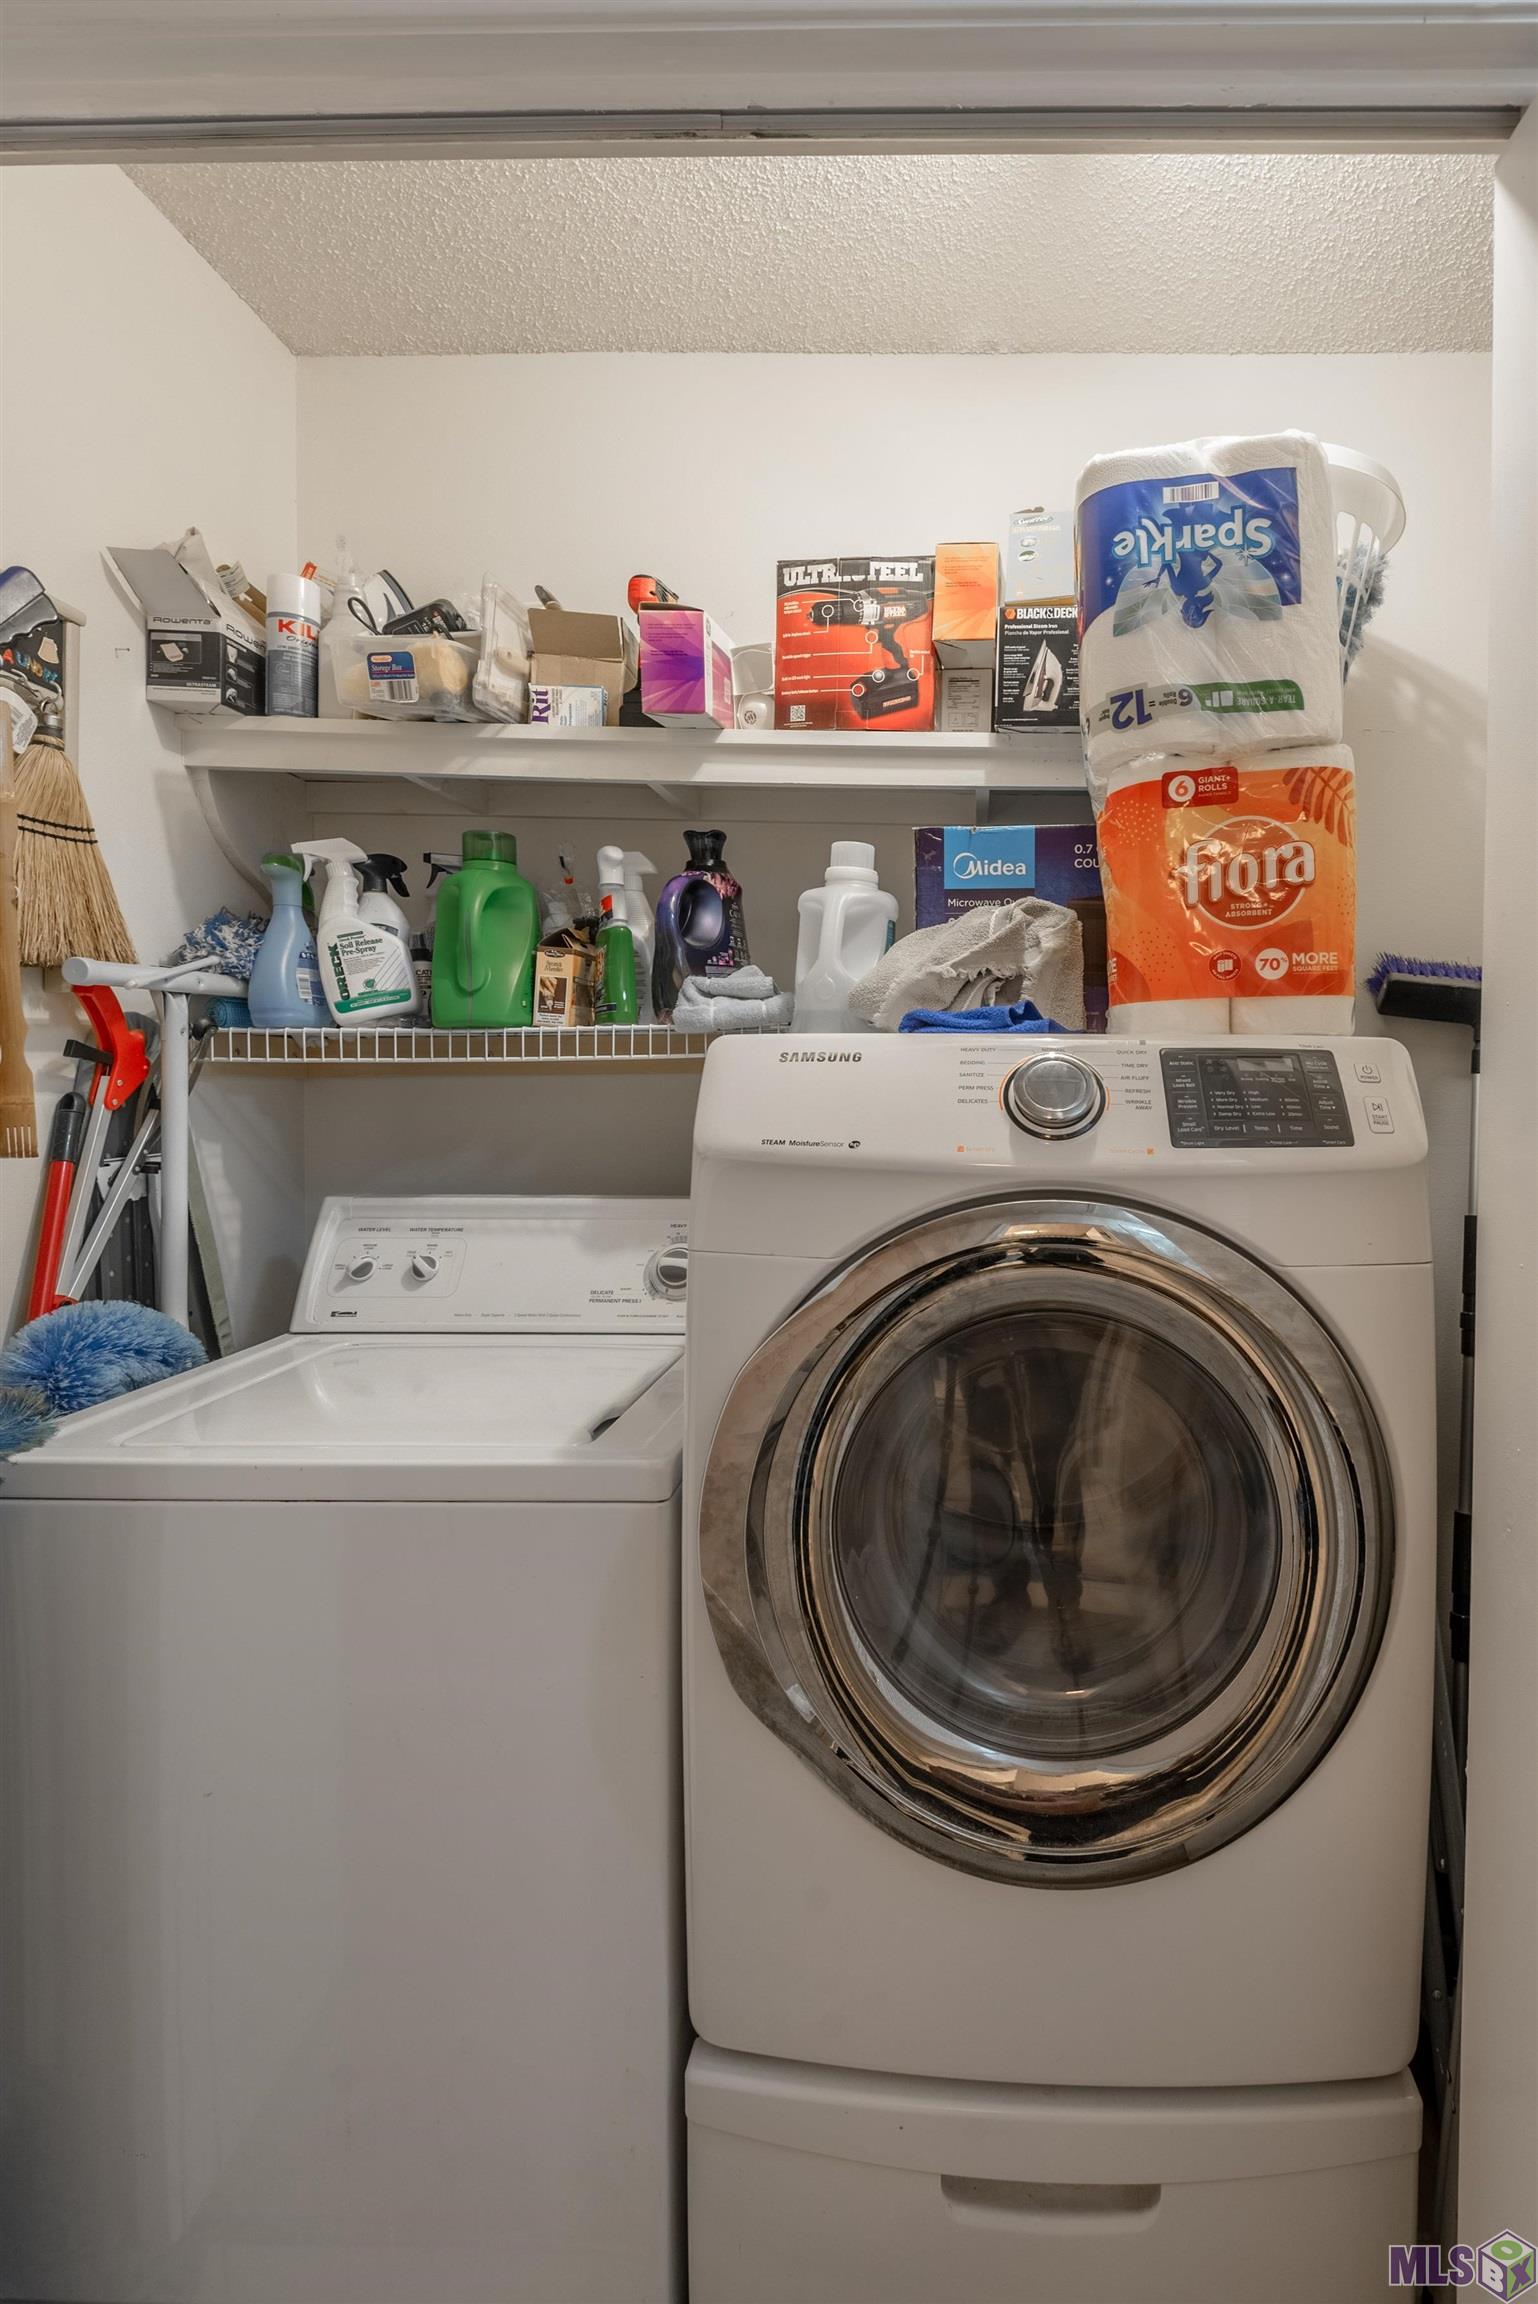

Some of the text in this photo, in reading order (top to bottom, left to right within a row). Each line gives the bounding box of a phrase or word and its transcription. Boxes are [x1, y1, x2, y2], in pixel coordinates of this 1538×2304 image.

[1112, 508, 1273, 565] Sparkle
[277, 619, 320, 641] KIL
[531, 688, 552, 723] Rit
[1178, 689, 1194, 707] 6
[1110, 689, 1153, 730] 12
[1174, 779, 1189, 797] 6
[1198, 782, 1228, 792] ROLLS
[1074, 843, 1093, 854] 0.7
[959, 857, 1027, 877] Midea
[1180, 840, 1315, 907] fiora
[947, 897, 1002, 907] Microwave
[1225, 908, 1274, 918] ABSORBENT
[339, 940, 354, 951] Soil
[355, 937, 383, 947] Release
[341, 945, 377, 957] Pre-Spray
[1292, 952, 1338, 965] MORE
[327, 943, 351, 1001] ORECK
[778, 1051, 863, 1063] SAMSUNG
[761, 1138, 786, 1146] STEAM
[788, 1139, 845, 1148] MoistureSensor
